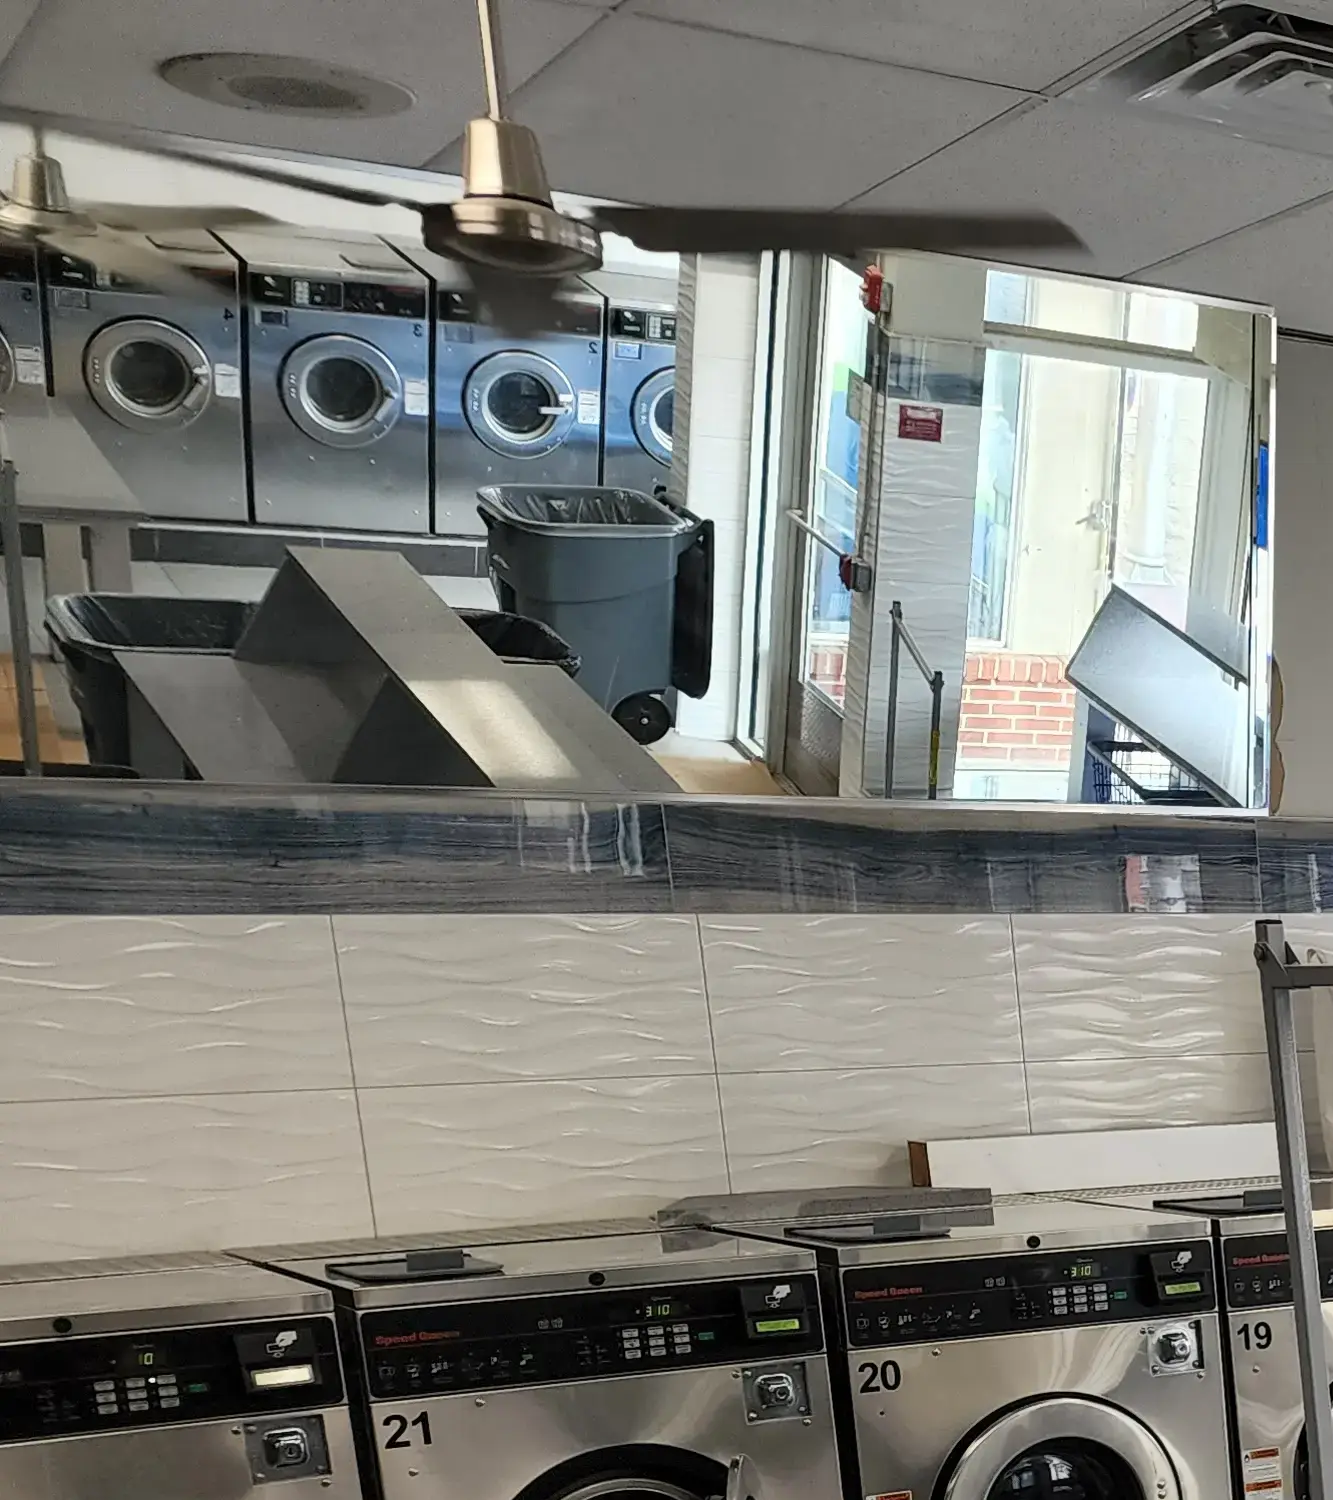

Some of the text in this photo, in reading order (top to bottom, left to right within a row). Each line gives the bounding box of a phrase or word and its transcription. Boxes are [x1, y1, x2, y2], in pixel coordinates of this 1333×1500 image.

[1236, 1321, 1273, 1351] 19
[857, 1360, 901, 1394] 20
[382, 1411, 434, 1450] 21
